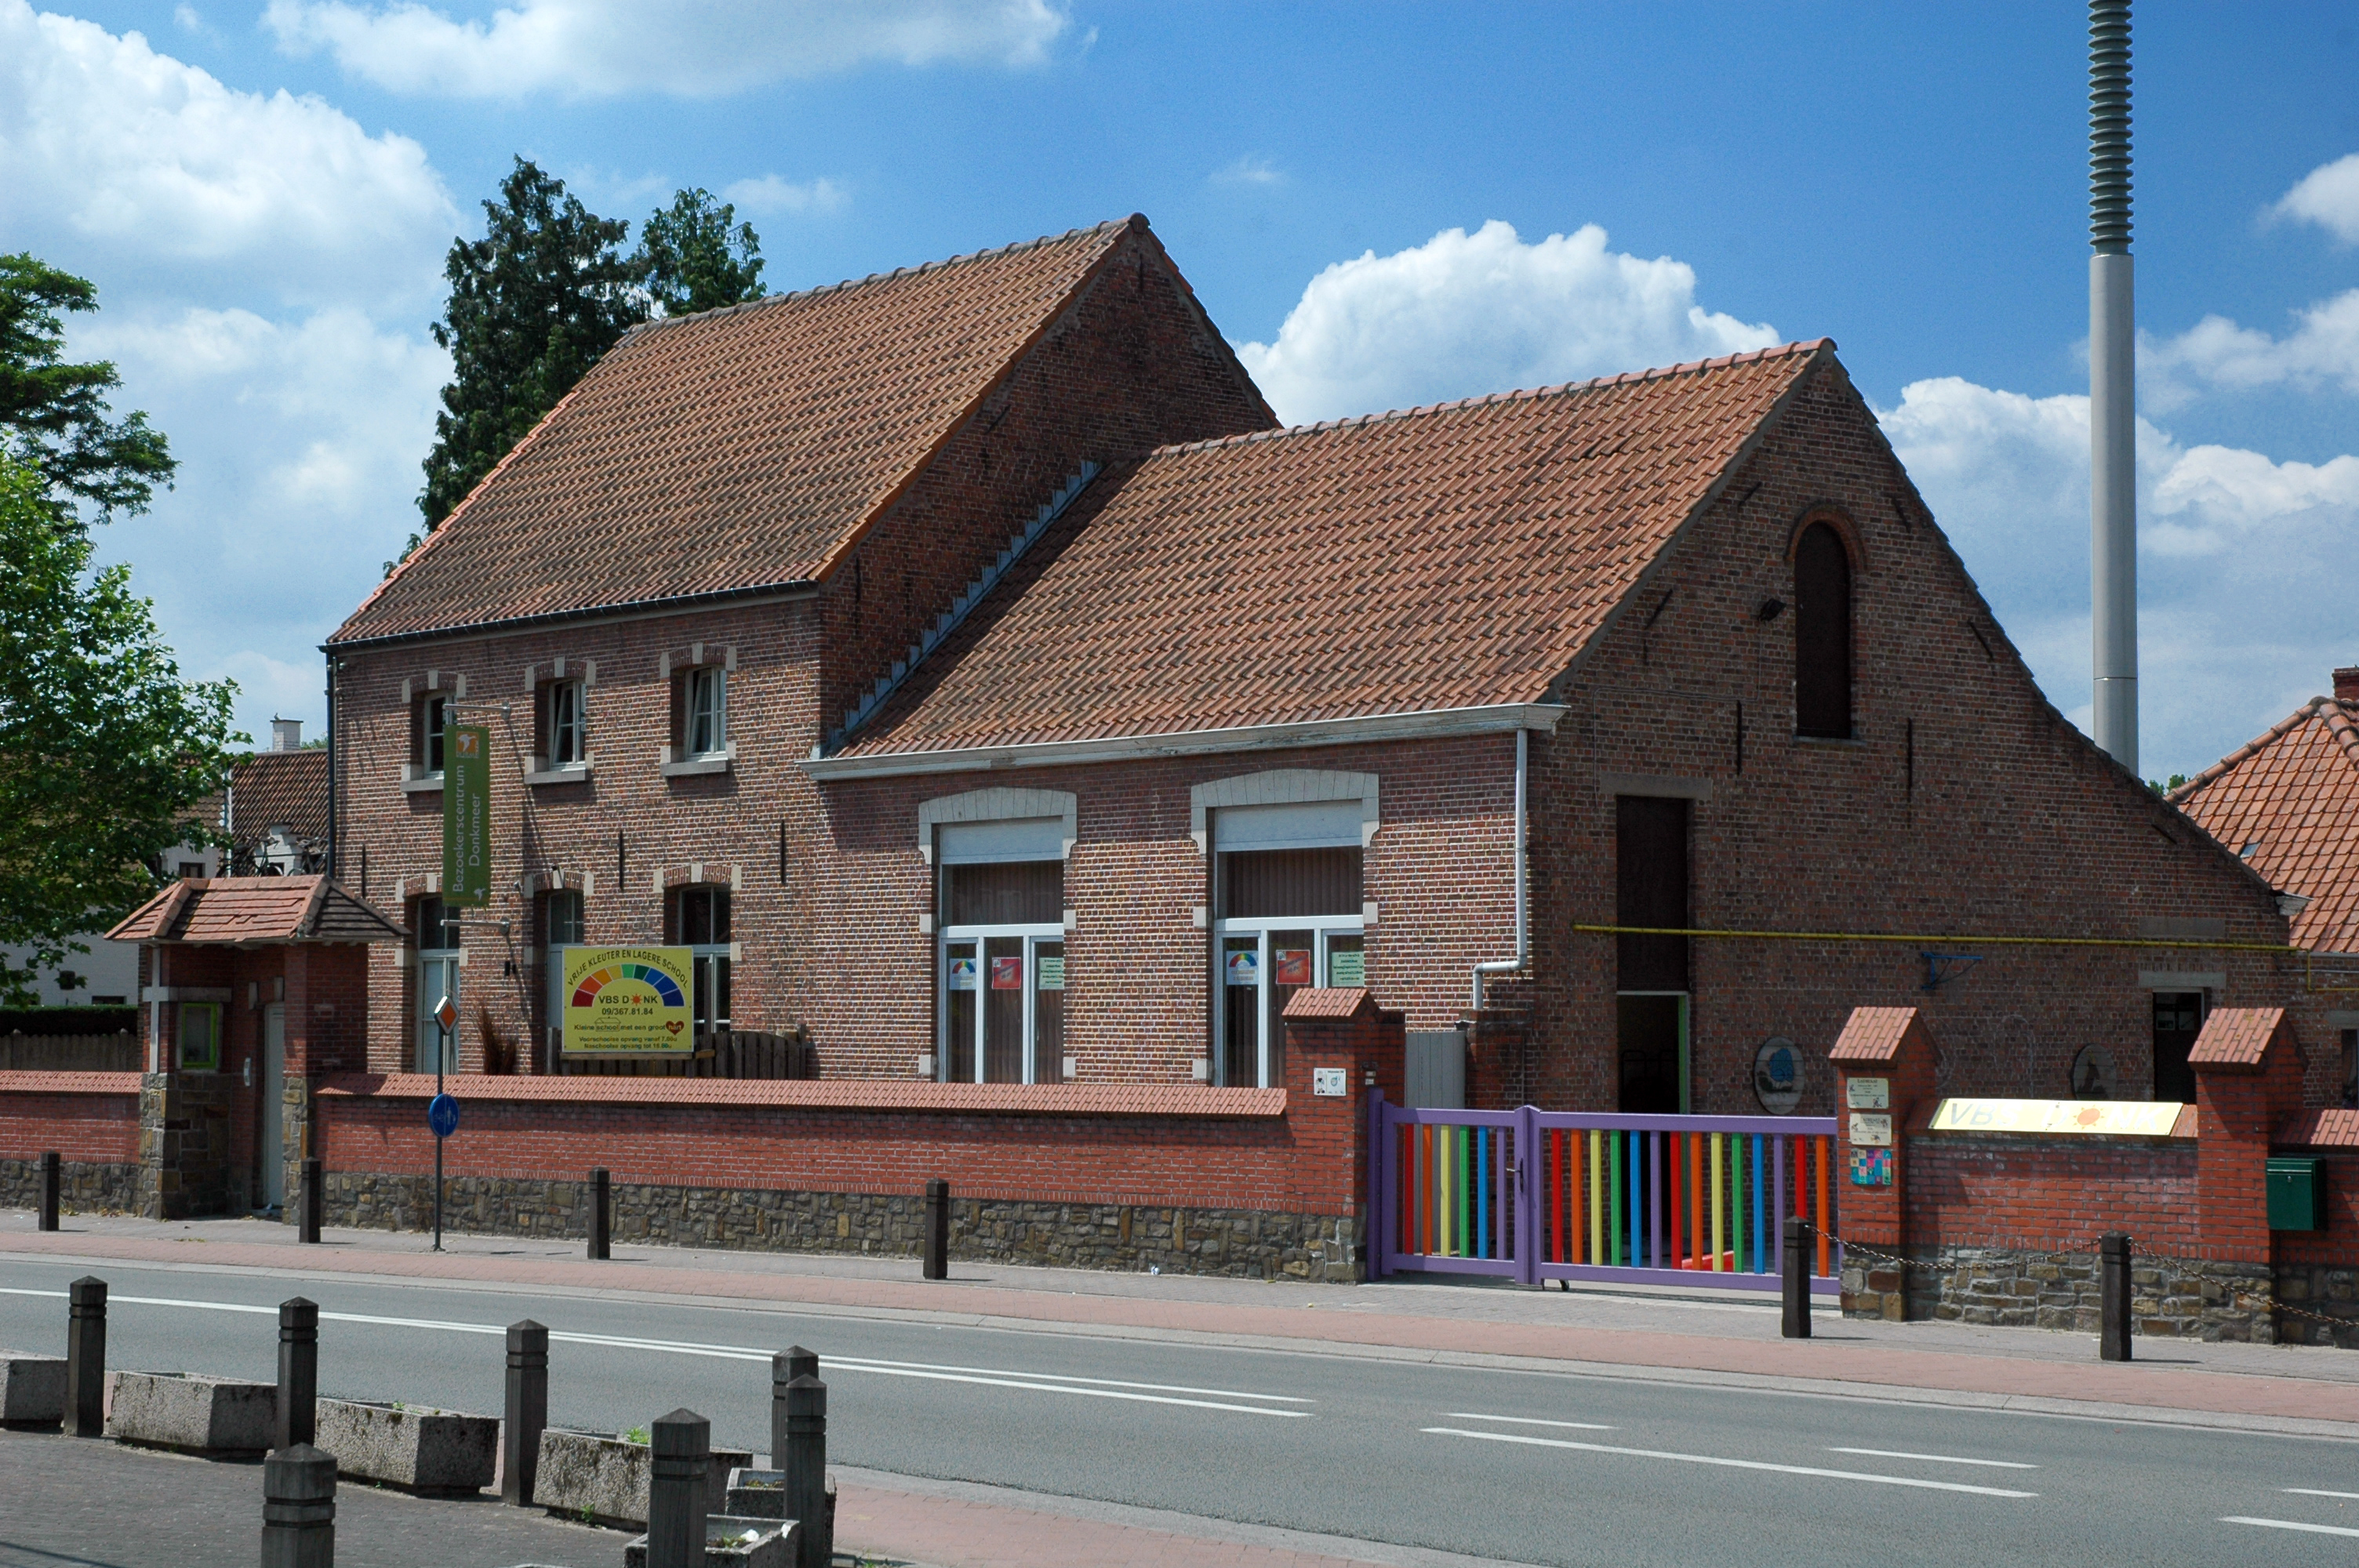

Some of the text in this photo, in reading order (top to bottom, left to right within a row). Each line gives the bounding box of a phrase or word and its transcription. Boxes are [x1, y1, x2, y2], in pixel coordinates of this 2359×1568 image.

[453, 765, 464, 892] Bezoekerscentrum
[469, 793, 481, 866] Donkmeer
[567, 949, 689, 989] VRIJE KLEUTER EN LAGERE SCHOOL
[598, 996, 619, 1004] VBS
[1949, 1102, 2023, 1127] VBS
